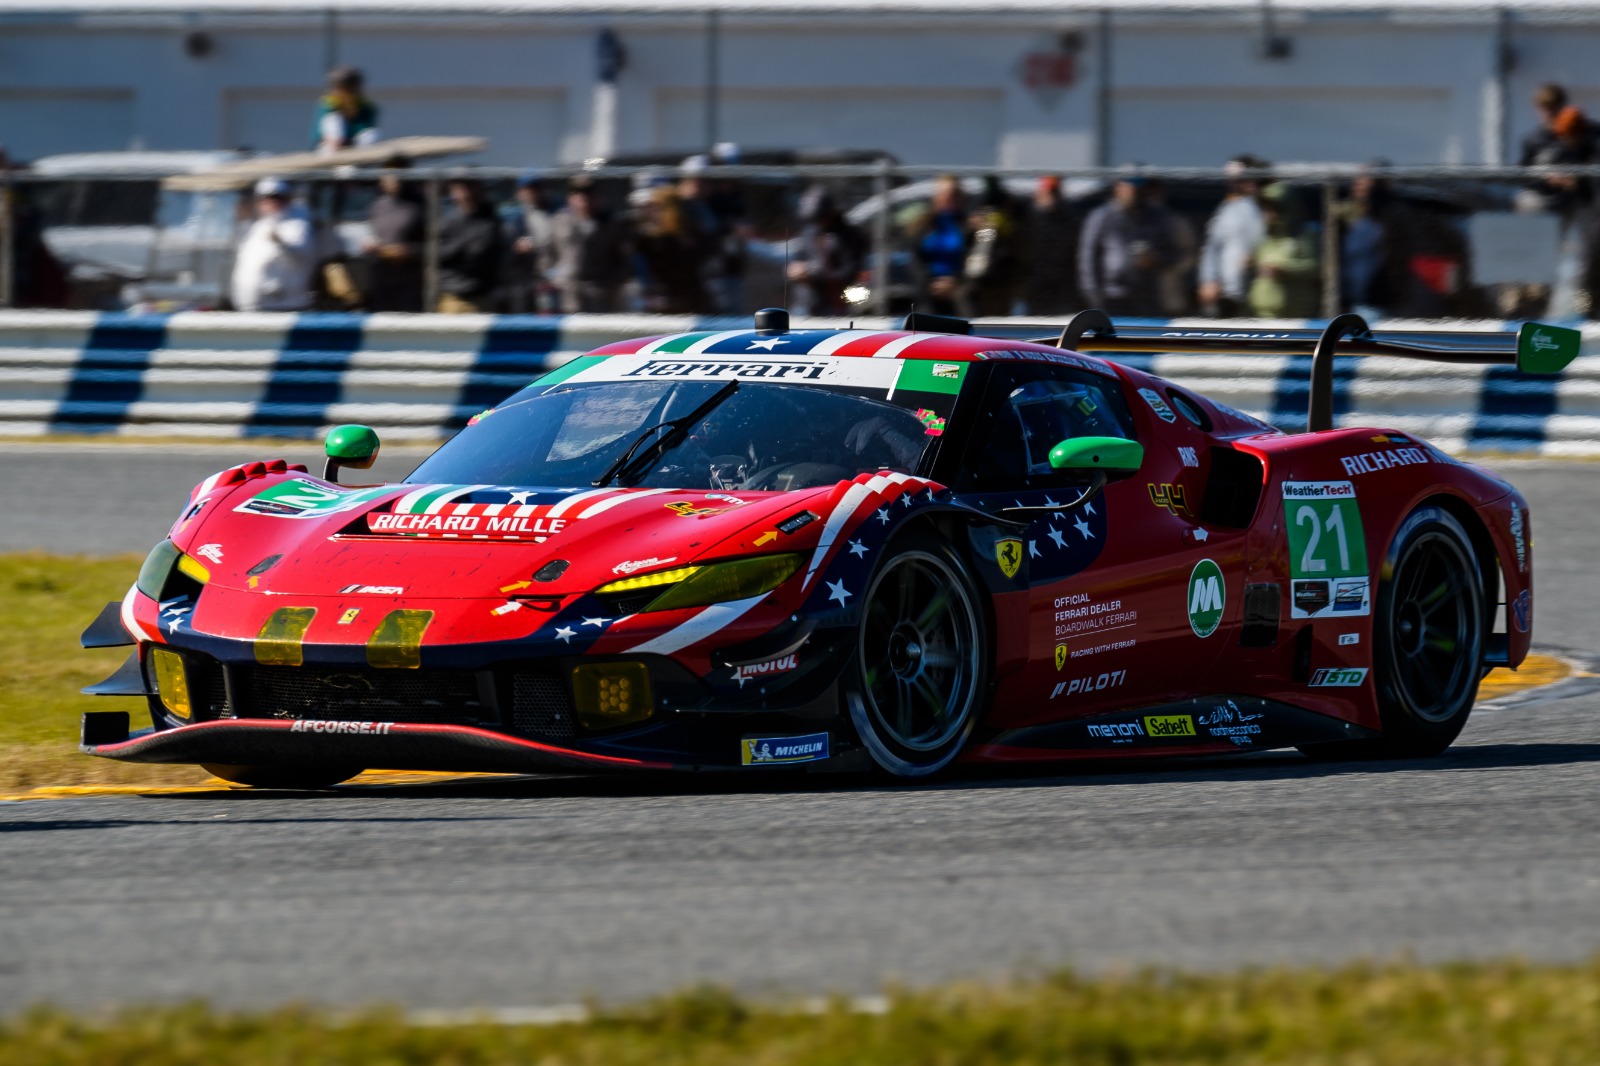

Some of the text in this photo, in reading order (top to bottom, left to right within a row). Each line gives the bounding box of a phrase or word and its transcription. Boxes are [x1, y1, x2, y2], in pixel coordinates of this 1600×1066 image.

[621, 360, 828, 380] Ferrari
[1339, 447, 1429, 477] RICHARD
[1285, 485, 1352, 497] WeatherTech
[369, 514, 567, 534] RICHARD MILLE
[1296, 503, 1351, 573] 21
[1054, 593, 1091, 609] OFFICIAL
[1055, 600, 1122, 622] FERRARI DEALER
[1055, 610, 1138, 636] BOARDWALK FERRARI
[1070, 639, 1137, 659] RACING WITH FERRARI
[742, 654, 797, 675] MOTUL
[1066, 669, 1127, 697] PILOTI
[290, 719, 396, 735] AFCORSE.IT
[1150, 717, 1191, 736] Sabelt
[774, 741, 823, 757] MICHELIN
